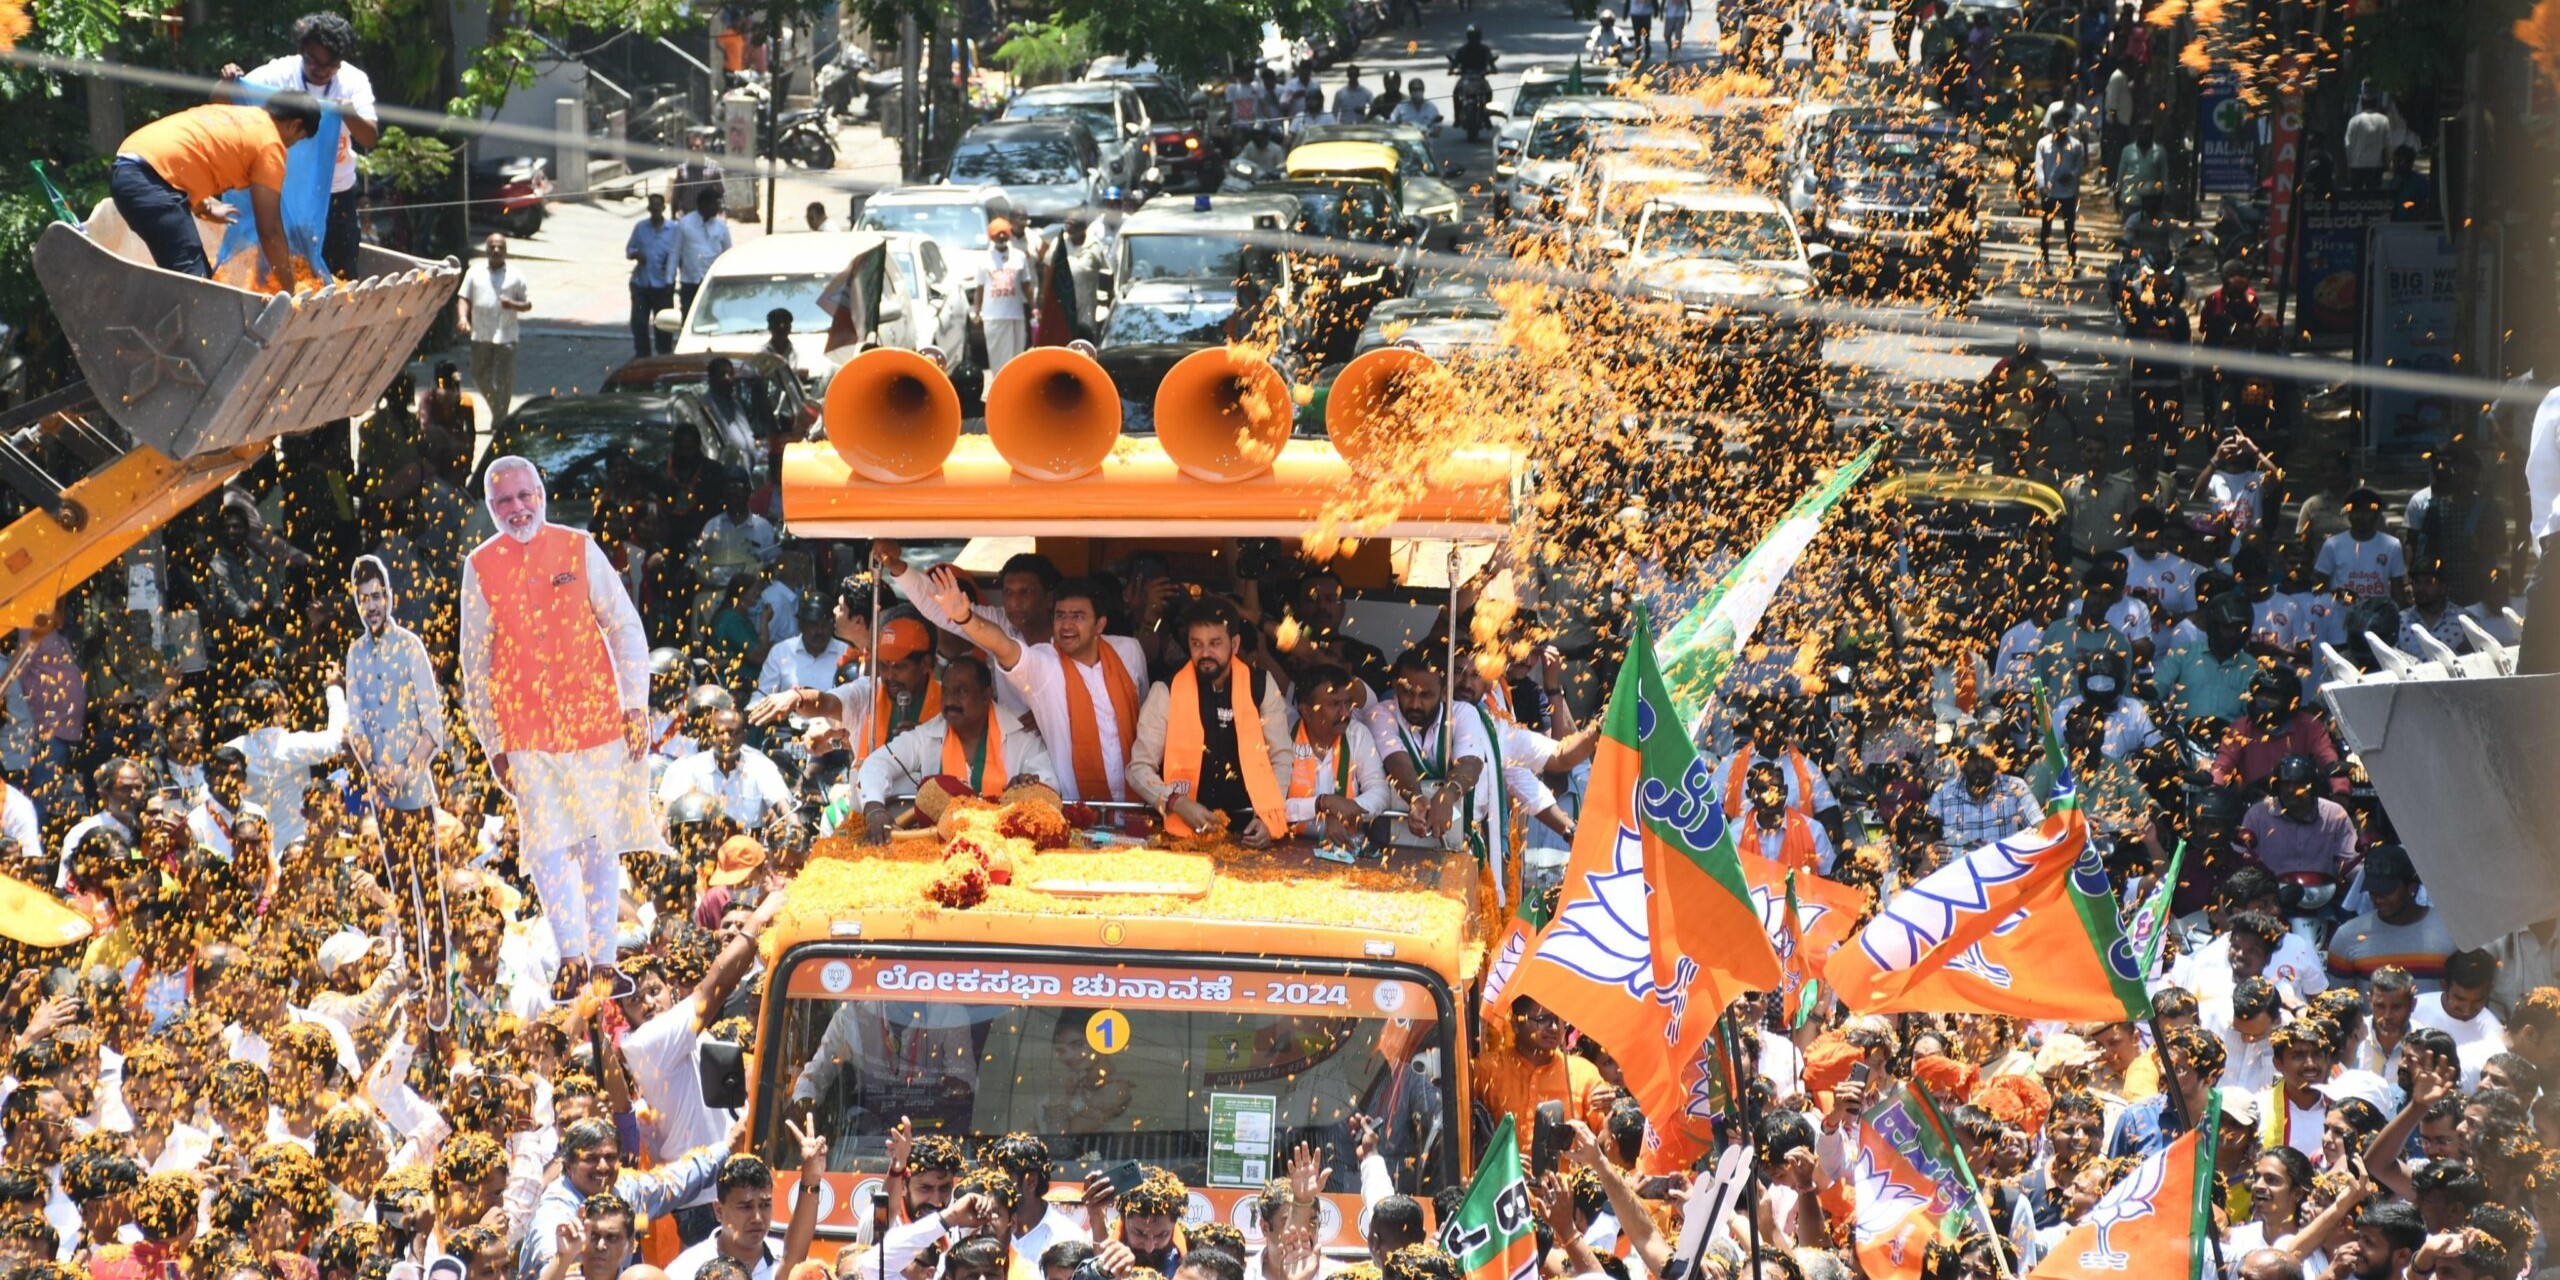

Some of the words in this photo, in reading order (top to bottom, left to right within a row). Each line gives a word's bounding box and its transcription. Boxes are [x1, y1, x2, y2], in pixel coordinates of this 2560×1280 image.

[2389, 271, 2424, 290] BIG
[876, 964, 1061, 1000] ಲೋಕಸಭಾ
[1071, 972, 1233, 1001] ಚುನಾವಣೆ
[1266, 982, 1349, 1004] 2024
[1095, 1018, 1113, 1048] 1
[1445, 1175, 1534, 1260] BJ
